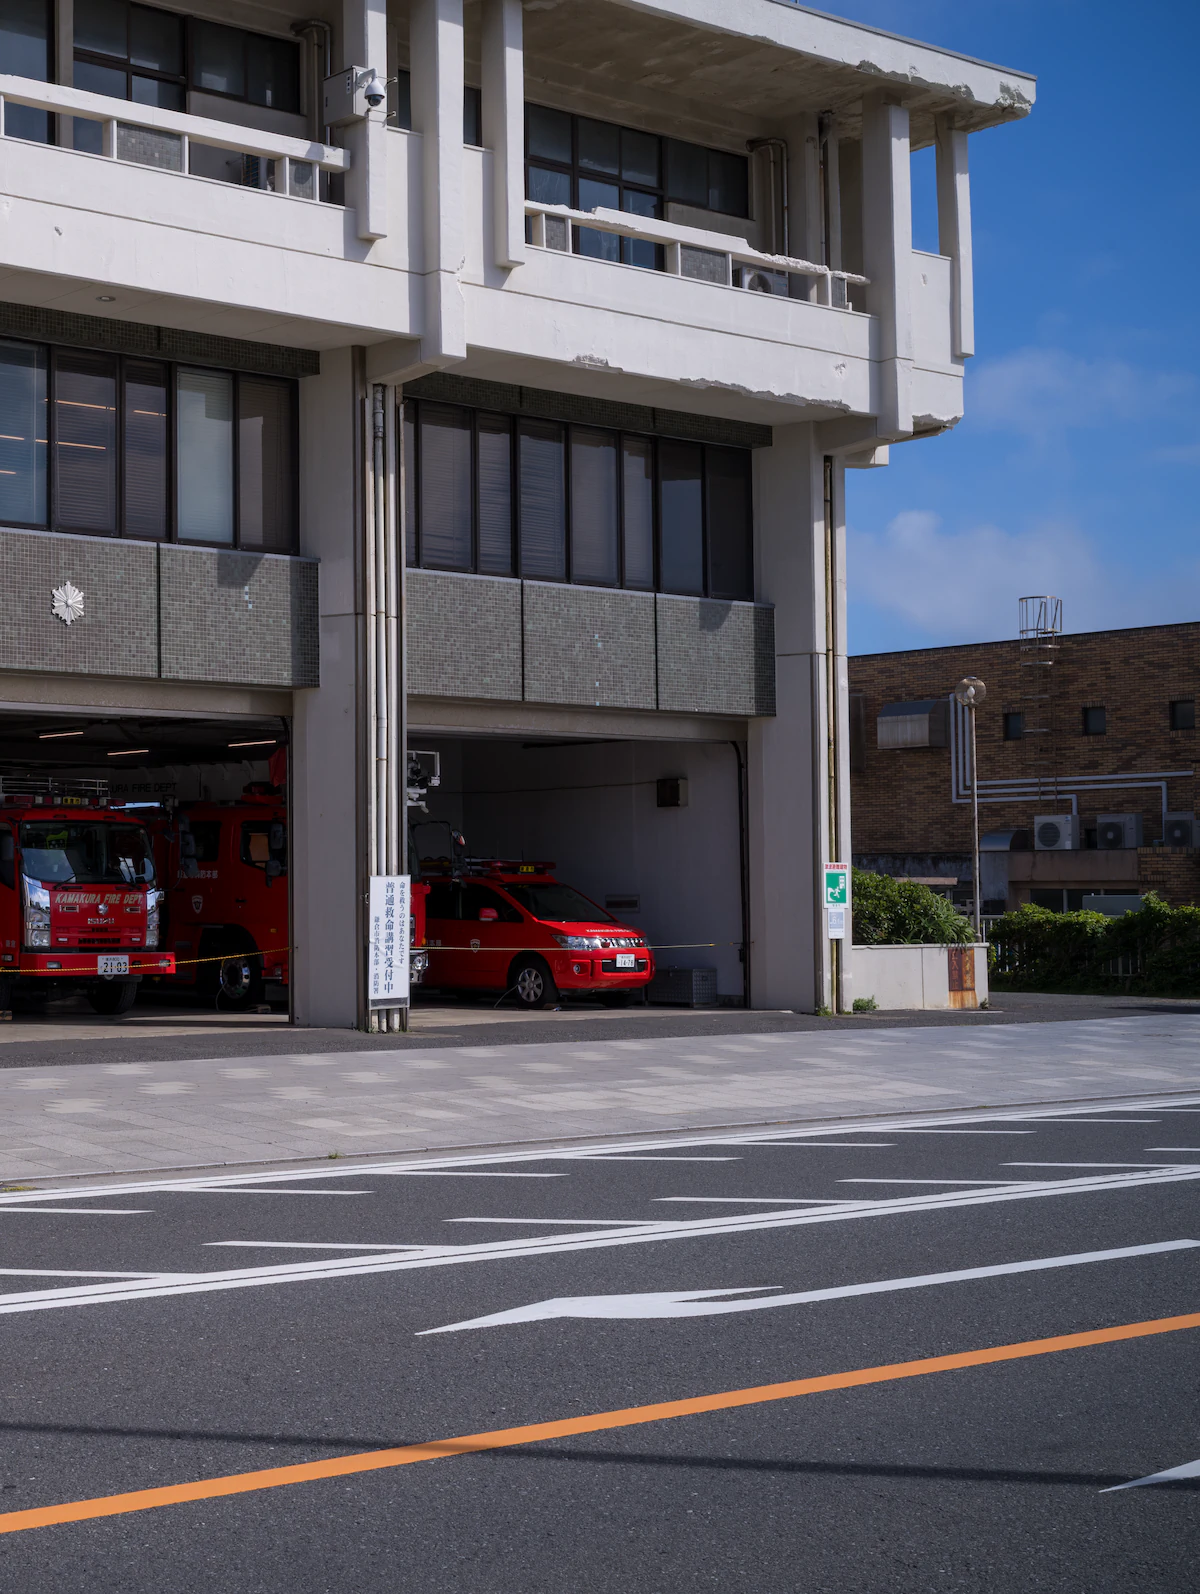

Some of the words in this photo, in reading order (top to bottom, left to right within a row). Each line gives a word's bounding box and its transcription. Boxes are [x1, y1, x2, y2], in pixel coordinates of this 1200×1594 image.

[132, 783, 151, 793] FIRE
[153, 782, 177, 793] DEPT
[55, 893, 101, 904] KAMAKURA
[103, 893, 122, 904] FIRE
[123, 893, 143, 905] DEPT.
[87, 917, 115, 925] ISUZU
[398, 881, 406, 965] 命を救うのはあなたです
[384, 881, 395, 994] 普通救命講習受付中
